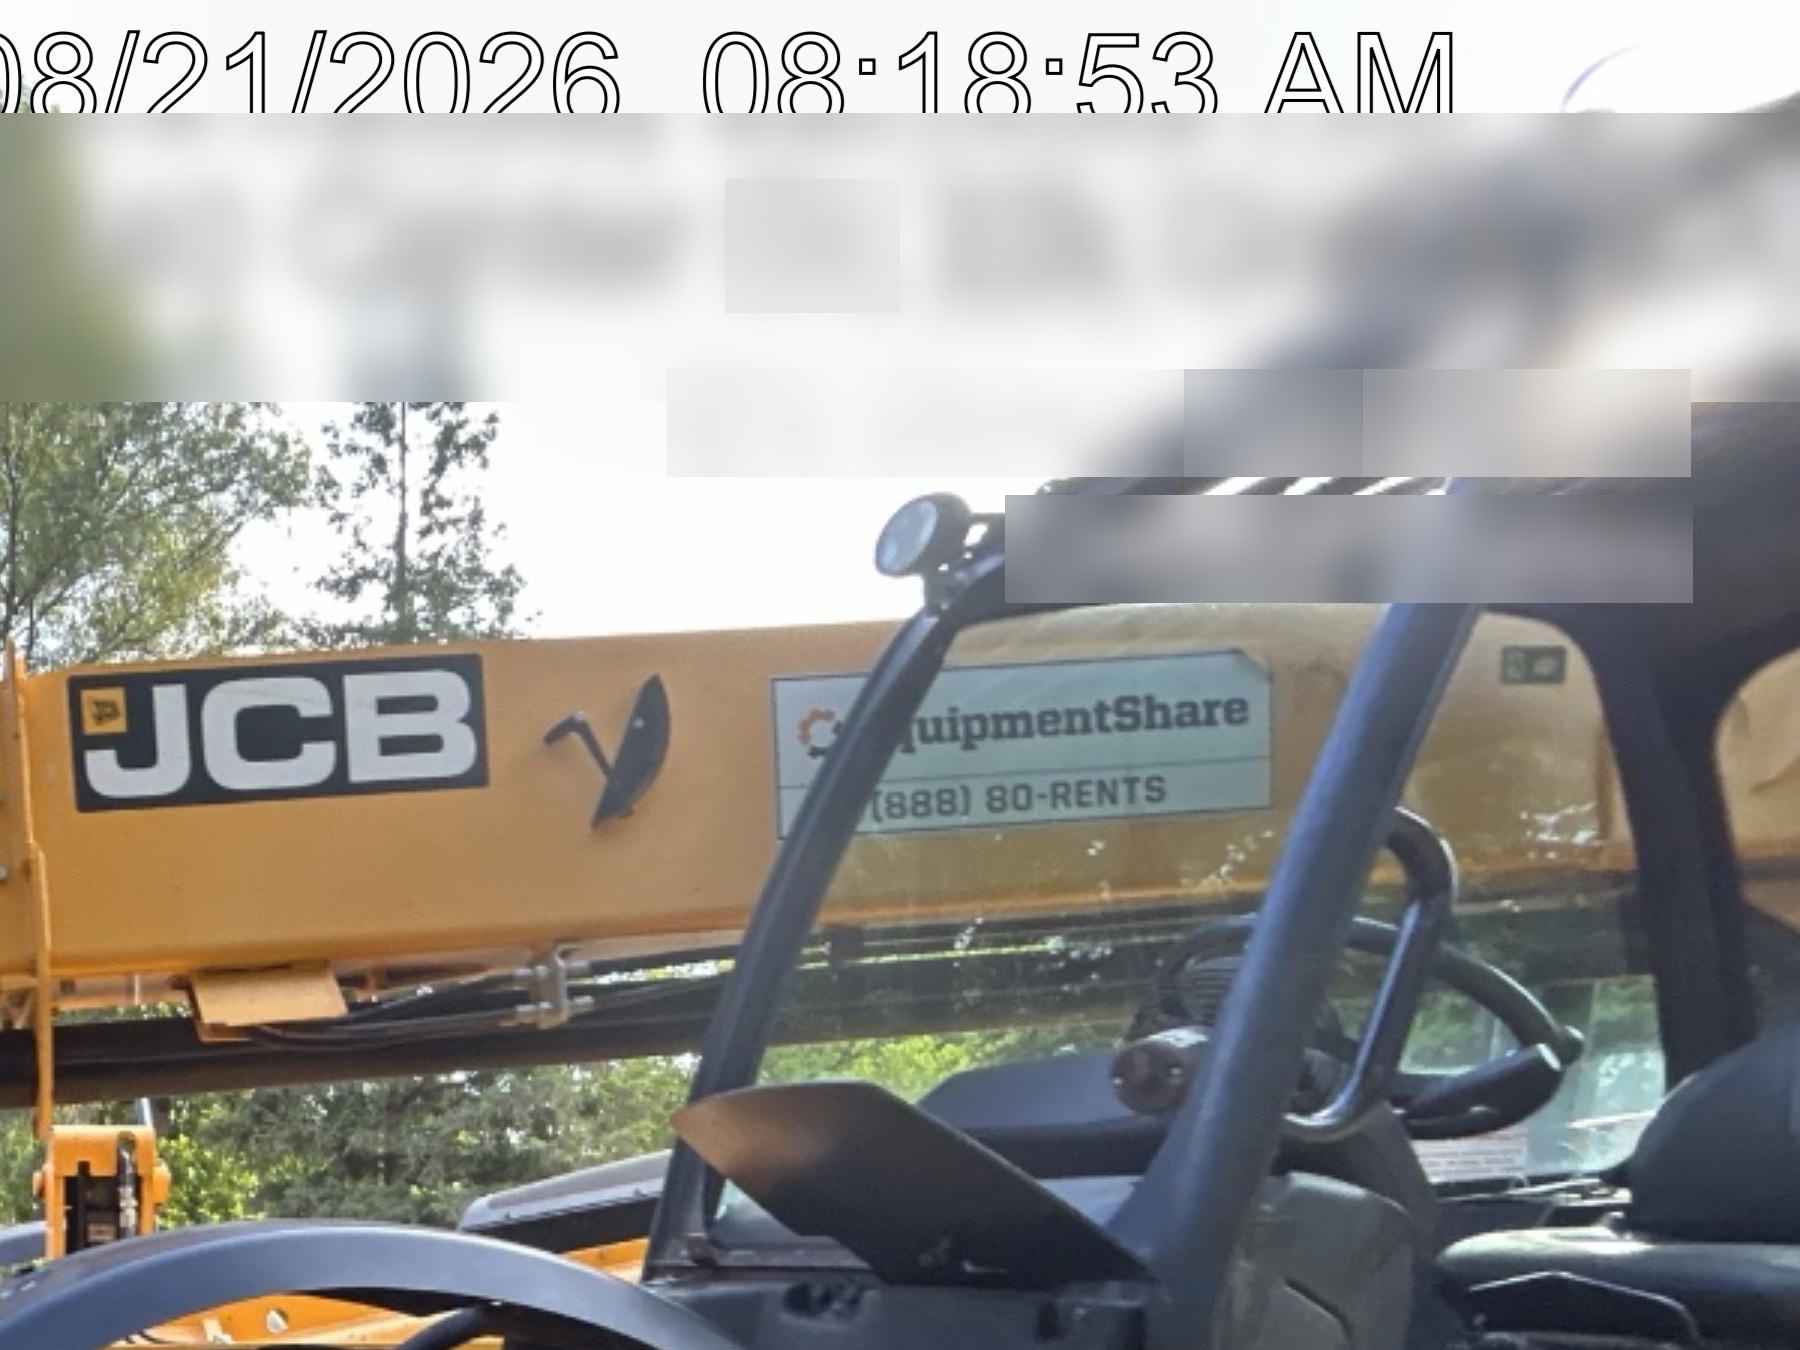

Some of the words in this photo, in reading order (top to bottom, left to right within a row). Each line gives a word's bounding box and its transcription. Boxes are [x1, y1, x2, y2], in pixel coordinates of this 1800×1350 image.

[85, 669, 478, 799] JCB
[900, 695, 1250, 754] uipmentShare
[872, 784, 971, 822] (888)
[986, 774, 1167, 814] 80-RENTS
